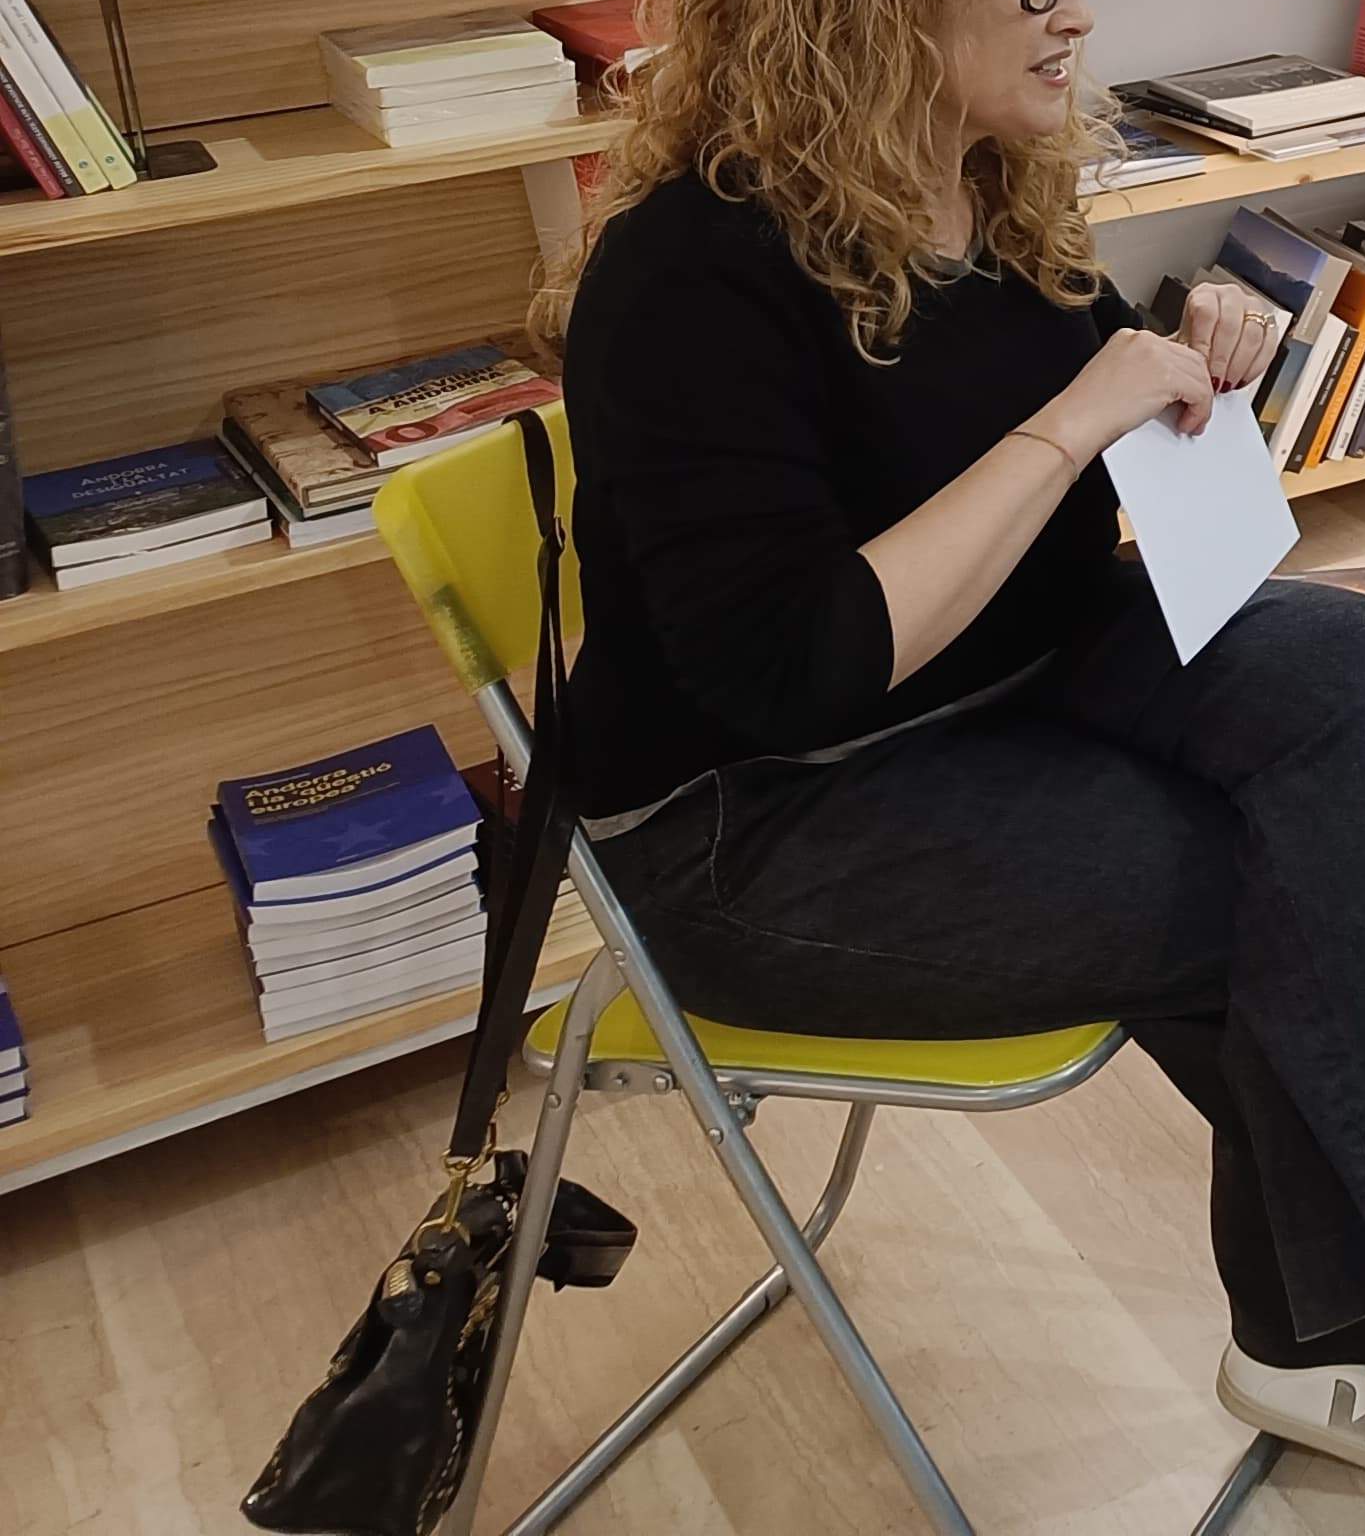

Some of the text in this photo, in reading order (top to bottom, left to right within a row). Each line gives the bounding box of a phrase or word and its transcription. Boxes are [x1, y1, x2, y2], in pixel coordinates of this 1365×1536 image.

[368, 370, 505, 415] A ANDORRA
[72, 468, 187, 499] DESIGUALTAT
[81, 463, 168, 486] ANDORRA
[245, 768, 348, 800] Andorra
[262, 794, 285, 805] la
